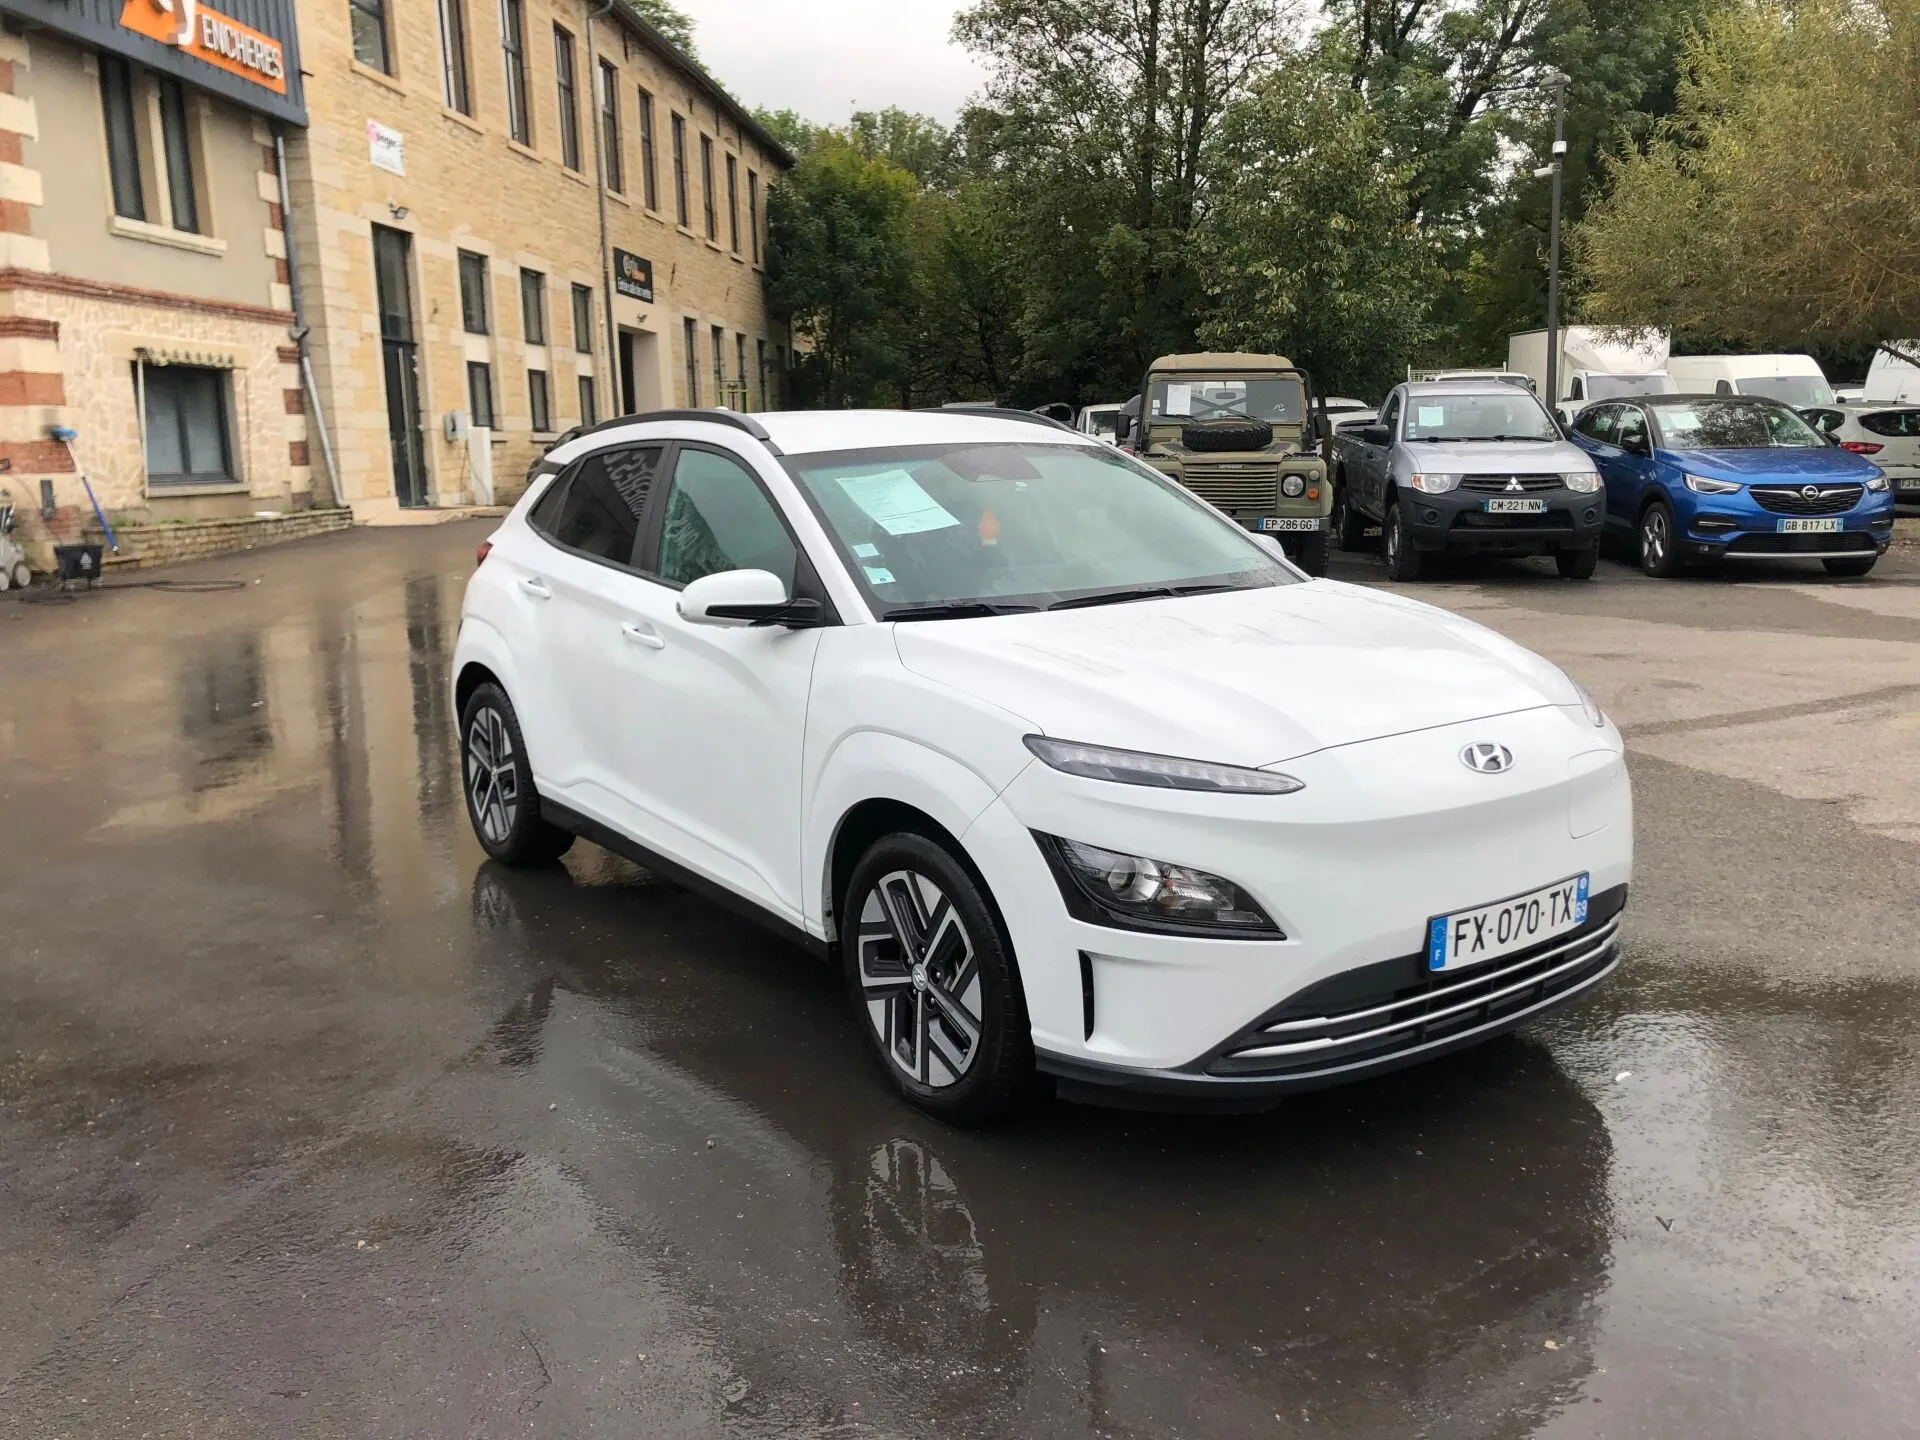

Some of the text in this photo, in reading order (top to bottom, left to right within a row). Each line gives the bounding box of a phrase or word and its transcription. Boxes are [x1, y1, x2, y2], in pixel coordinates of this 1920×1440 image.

[201, 14, 283, 79] ENCHERES
[1491, 501, 1541, 510] CM-221-NN
[1265, 519, 1313, 529] EP-286-GG
[1785, 520, 1836, 530] GB-817-LX
[1453, 886, 1573, 957] FX-070-TX
